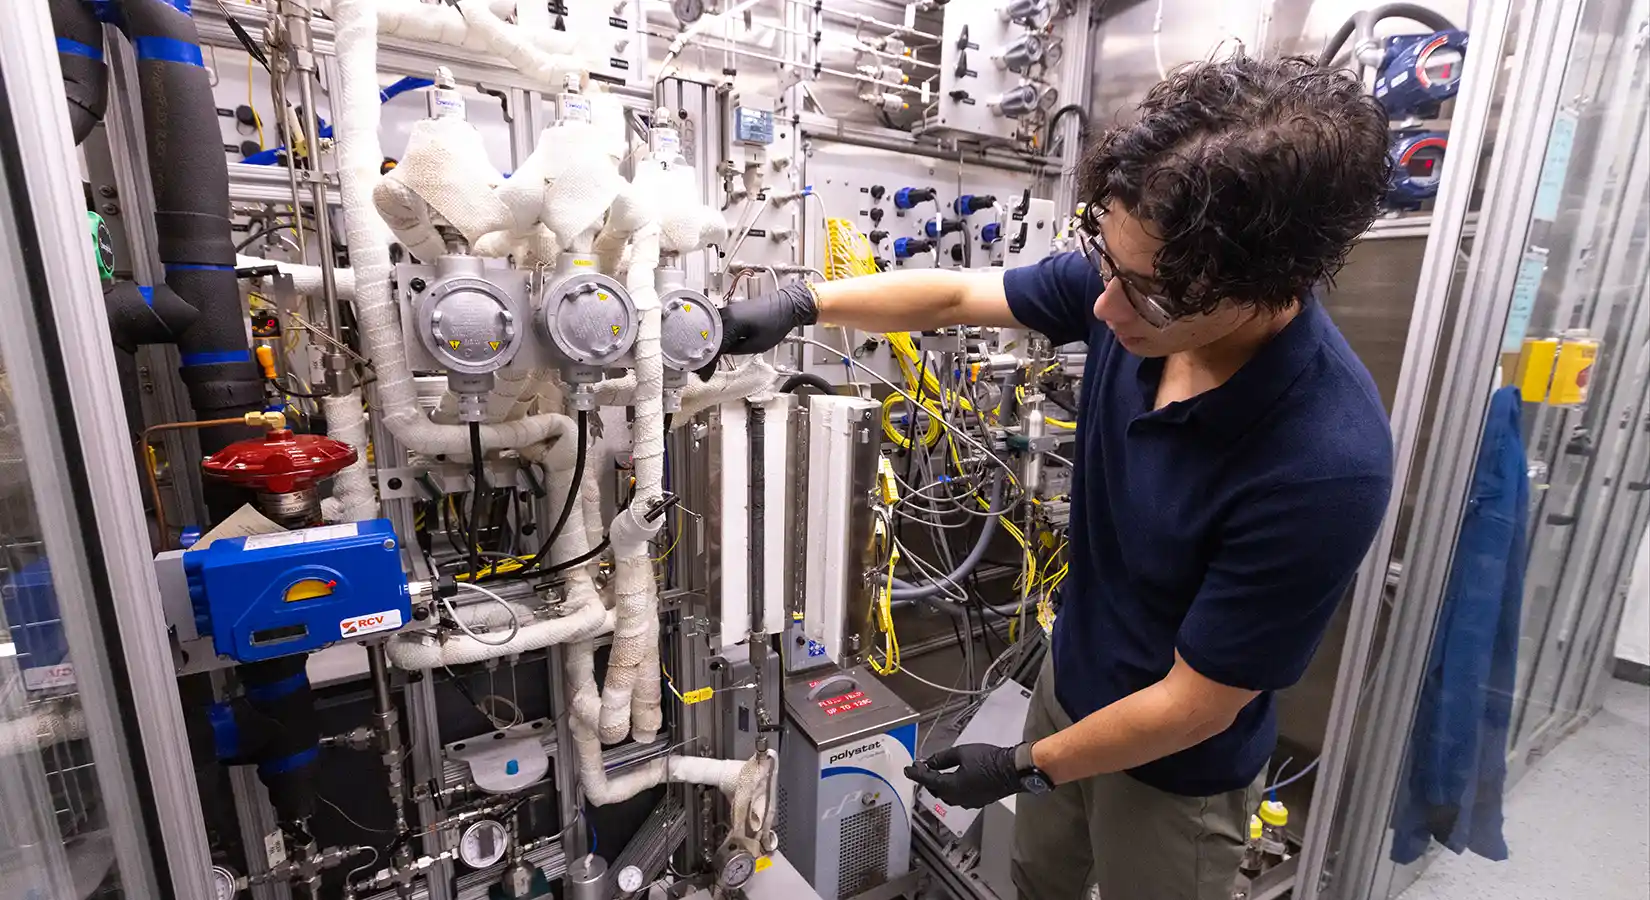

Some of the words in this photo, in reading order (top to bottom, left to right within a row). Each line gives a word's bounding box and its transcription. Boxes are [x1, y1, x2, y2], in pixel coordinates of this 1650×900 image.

[358, 616, 384, 627] RCV
[826, 707, 837, 715] UP
[829, 741, 881, 764] polystat
